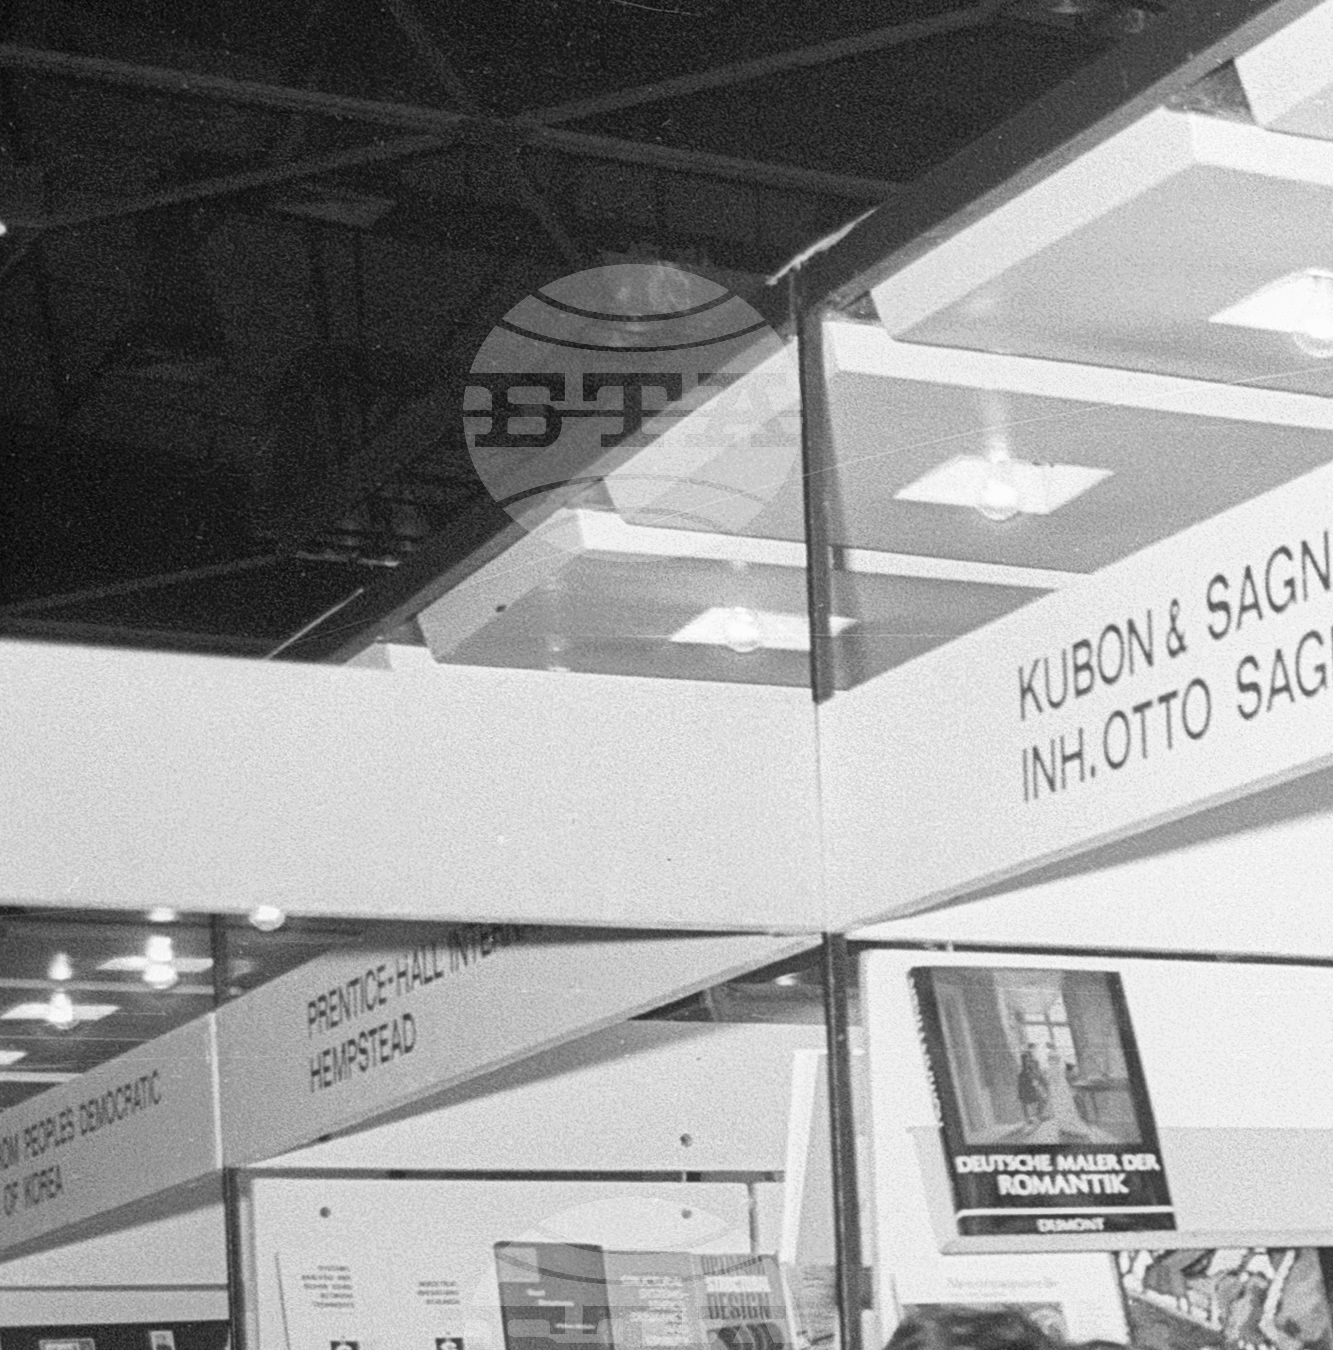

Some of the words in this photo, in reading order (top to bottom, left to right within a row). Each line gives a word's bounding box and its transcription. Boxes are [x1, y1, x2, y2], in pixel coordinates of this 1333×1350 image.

[1018, 610, 1155, 721] KUBON
[1165, 600, 1188, 656] &
[310, 1012, 417, 1093] HEMPSTEAD
[79, 1069, 162, 1136] DEMOCRATIC
[956, 1155, 1053, 1174] DEUTSCHE
[1057, 1154, 1119, 1172] MALER
[1122, 1153, 1161, 1172] DER
[997, 1173, 1129, 1196] ROMANTIK
[1037, 1216, 1105, 1233] DUMONT
